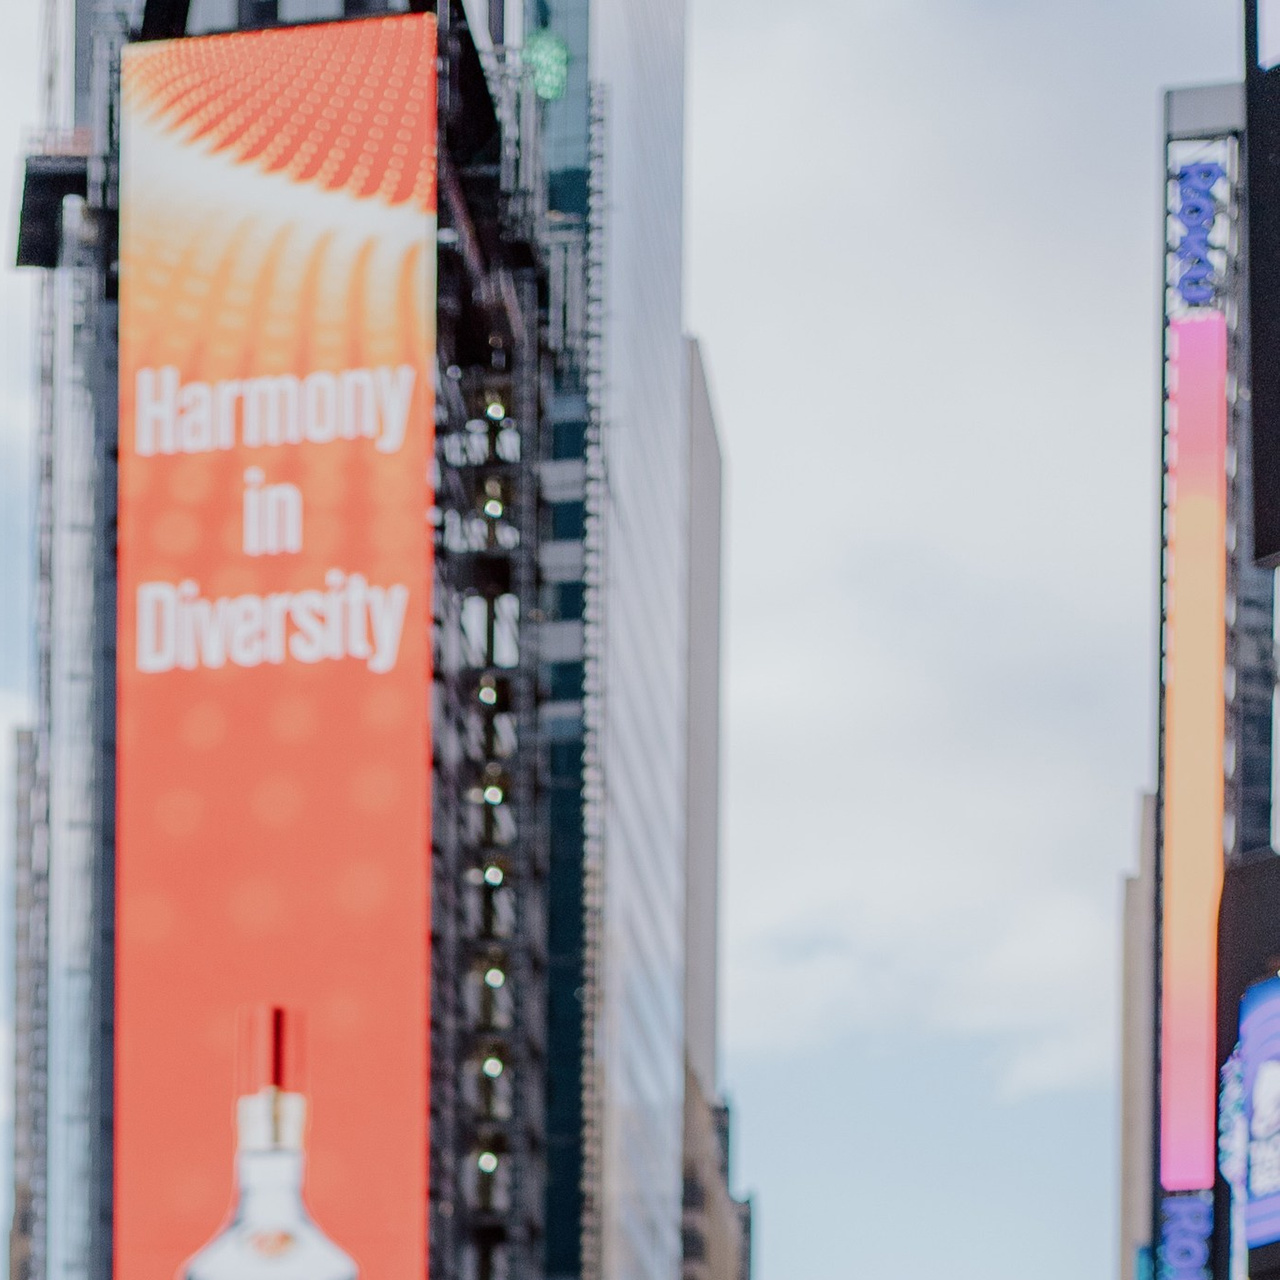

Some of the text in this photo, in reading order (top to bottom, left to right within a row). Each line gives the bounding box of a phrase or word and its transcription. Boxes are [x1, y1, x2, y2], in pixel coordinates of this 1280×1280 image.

[135, 365, 415, 455] Harmony
[243, 466, 303, 556] in
[136, 568, 409, 674] Diversity
